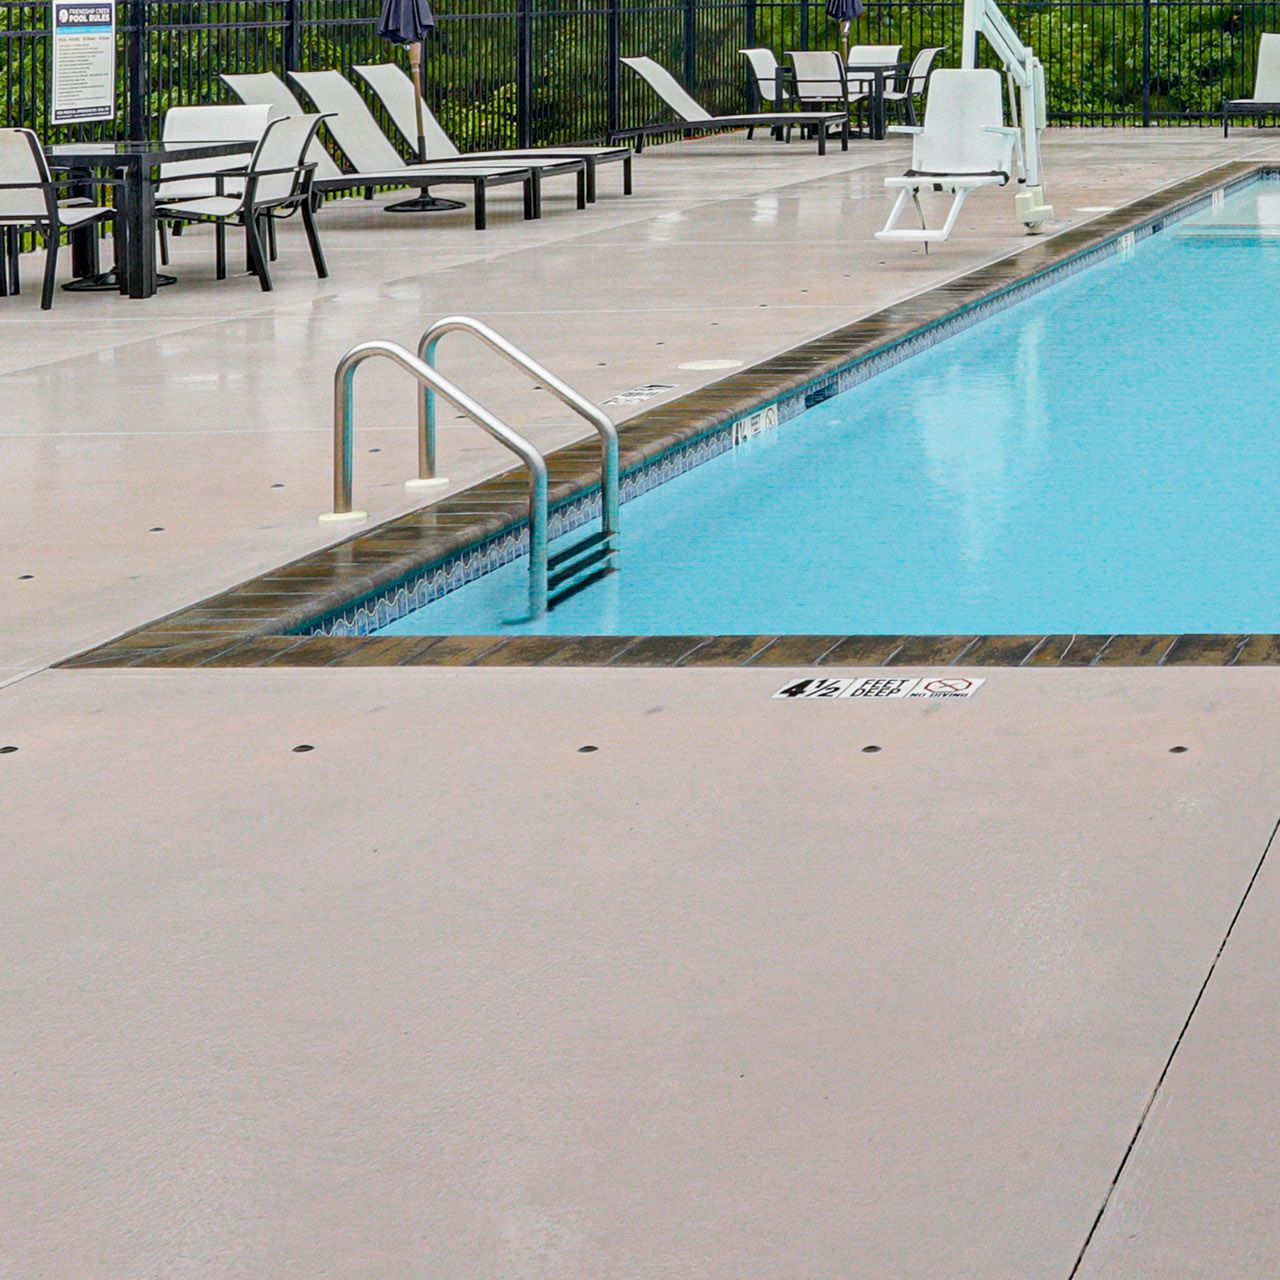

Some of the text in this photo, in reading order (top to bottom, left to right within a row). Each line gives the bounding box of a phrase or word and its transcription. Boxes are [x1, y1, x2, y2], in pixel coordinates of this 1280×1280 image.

[89, 14, 110, 22] RULES
[860, 679, 910, 689] FEET
[850, 688, 901, 697] DEEP
